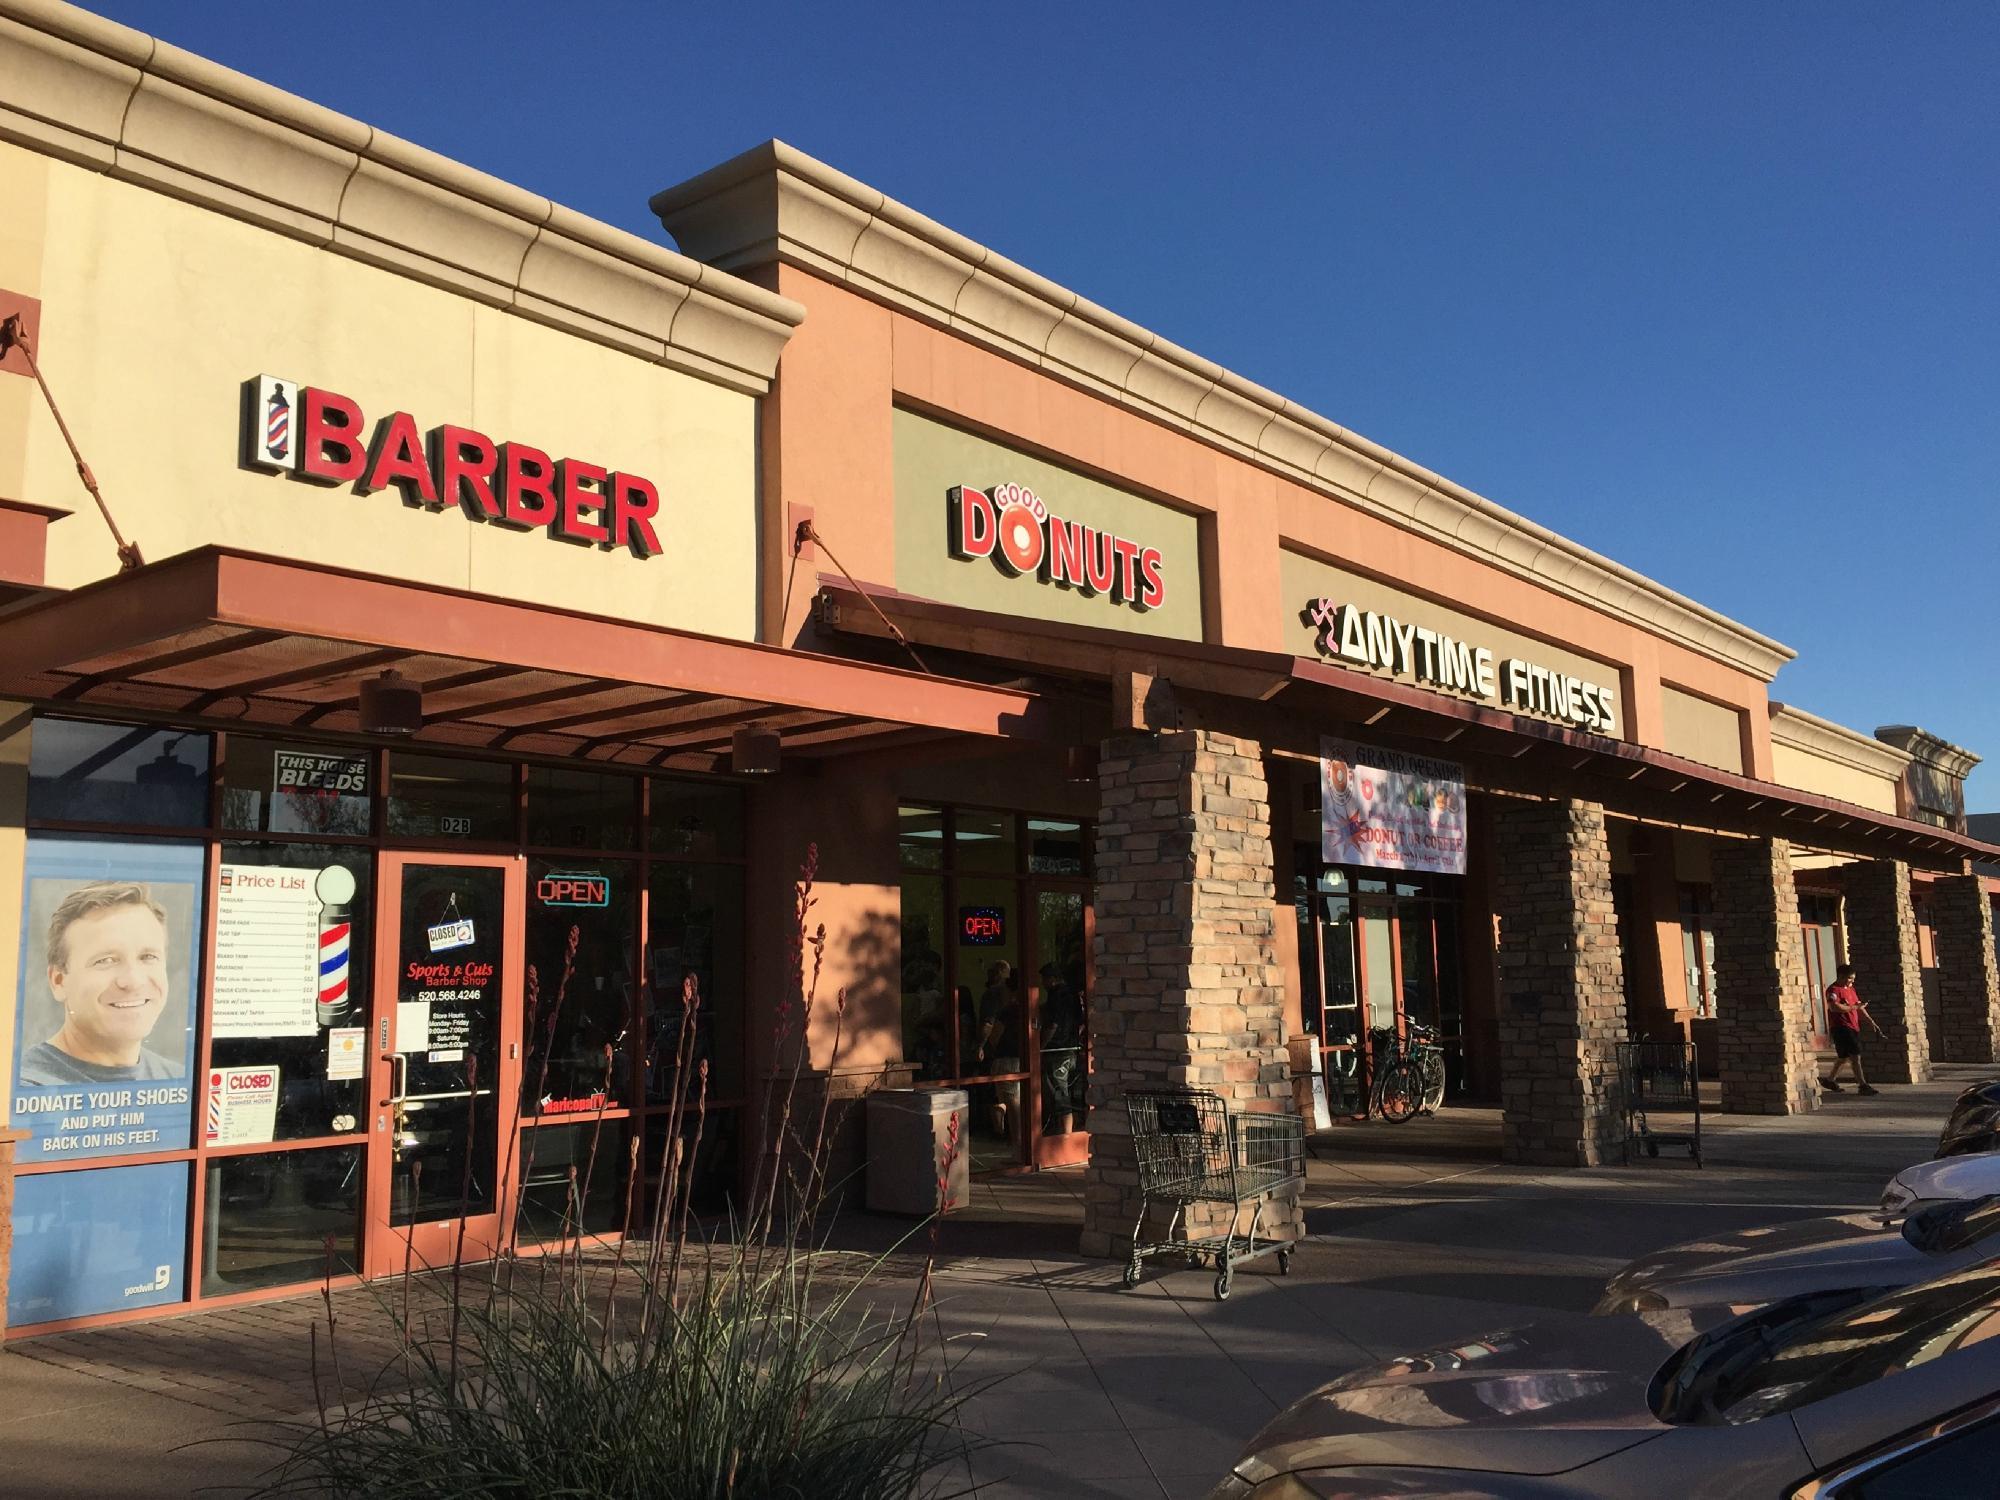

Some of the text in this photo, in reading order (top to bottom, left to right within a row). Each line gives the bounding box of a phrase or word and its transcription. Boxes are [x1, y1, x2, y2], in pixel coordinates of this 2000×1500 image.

[305, 386, 664, 555] BARBER
[994, 482, 1048, 524] GOOD
[961, 485, 1165, 609] DONUTS
[1340, 604, 1616, 731] ANYTIME FITNESS
[279, 755, 366, 775] THIS HOUSE
[1356, 745, 1405, 772] GRAND
[279, 769, 366, 792] BLEEDS
[442, 818, 470, 833] D2B
[1366, 827, 1405, 846] DONUT
[1424, 834, 1463, 853] COFFEE
[1376, 848, 1399, 861] March
[238, 875, 306, 889] Price List
[537, 880, 604, 902] OPEN
[429, 926, 456, 941] CLOSED
[965, 917, 1000, 935] OPEN
[407, 961, 493, 981] Sports & Cuts
[426, 976, 488, 986] Barber Shop
[418, 990, 481, 1001] 520.568.4246
[230, 1074, 272, 1089] CLOSED
[15, 1087, 188, 1114] DONATE YOUR SHOES
[60, 1112, 145, 1130] AND PUT HIM
[42, 1129, 160, 1152] BACK ON HIS FEET.
[124, 1282, 154, 1297] goodwill
